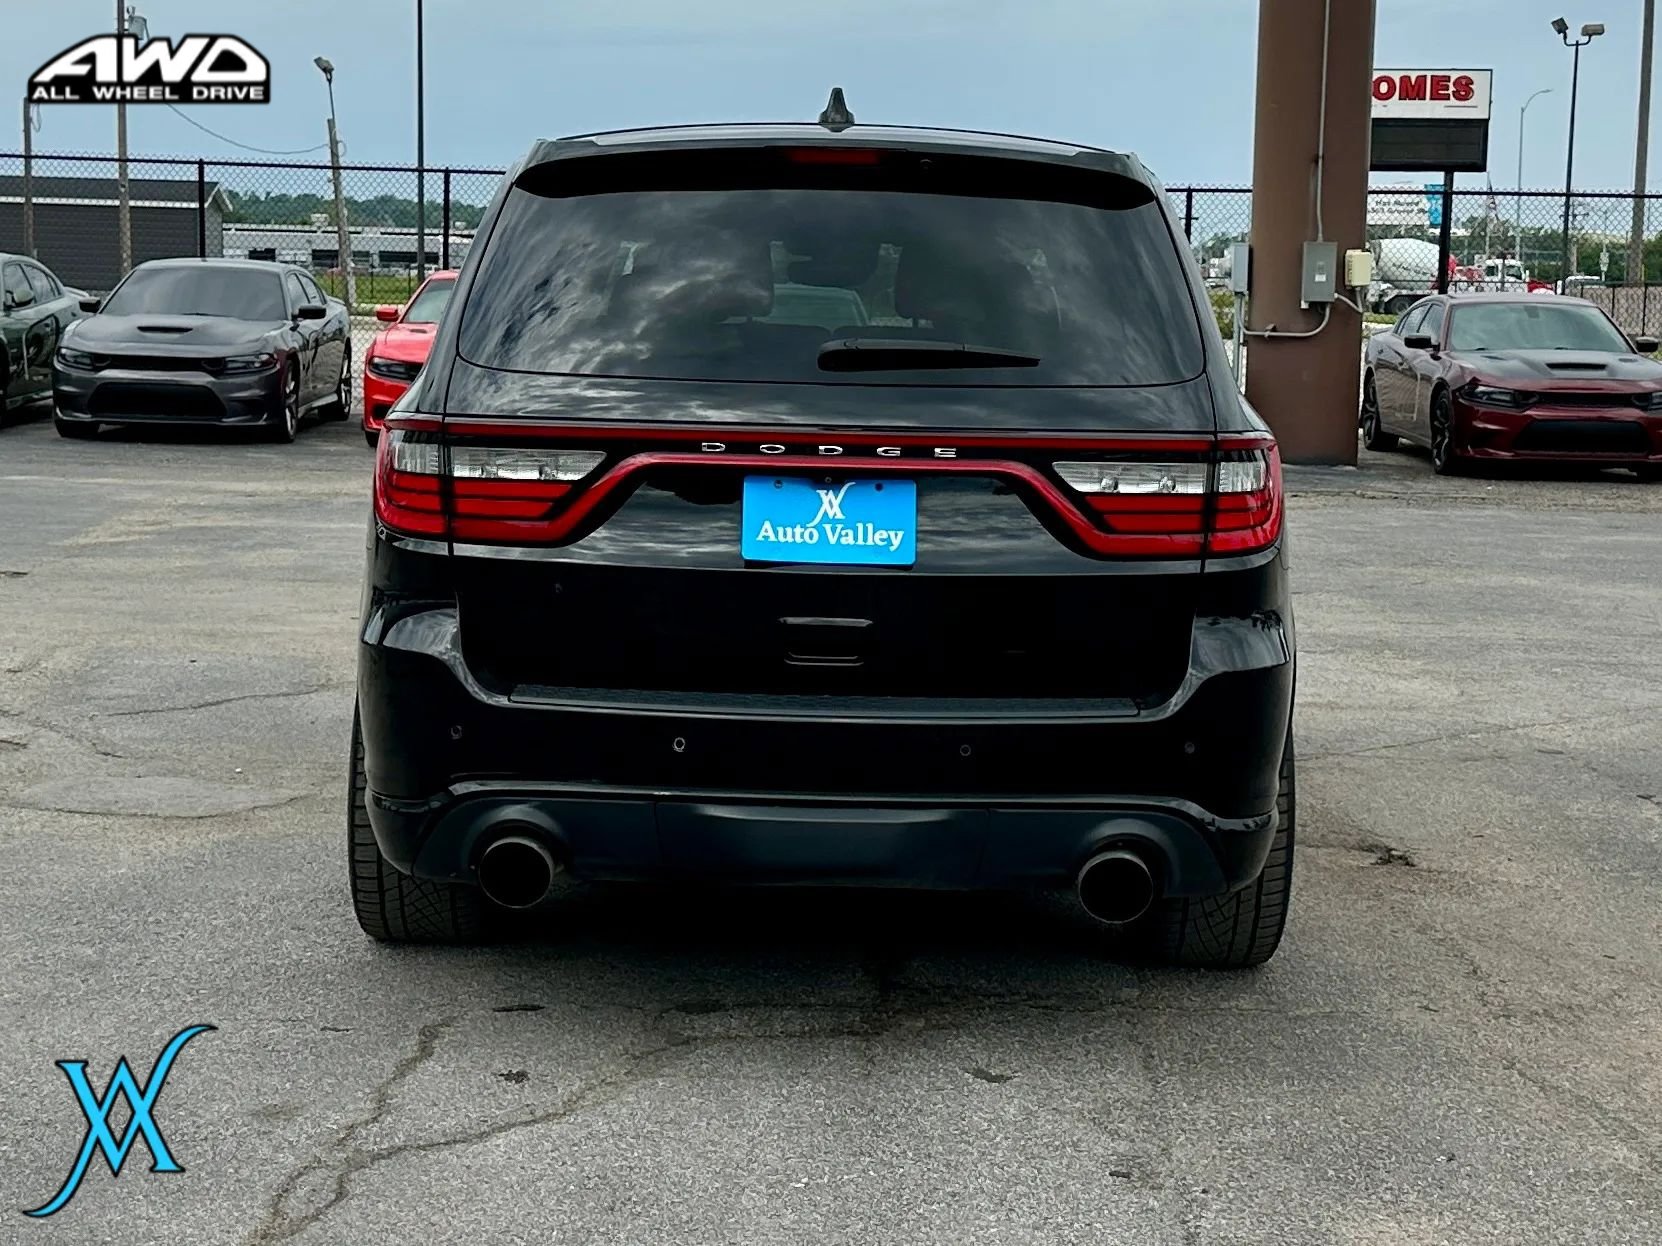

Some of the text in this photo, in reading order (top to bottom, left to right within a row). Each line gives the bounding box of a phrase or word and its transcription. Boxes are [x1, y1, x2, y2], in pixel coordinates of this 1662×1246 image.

[701, 442, 957, 458] DODGE
[756, 520, 905, 552] Auto Valley
